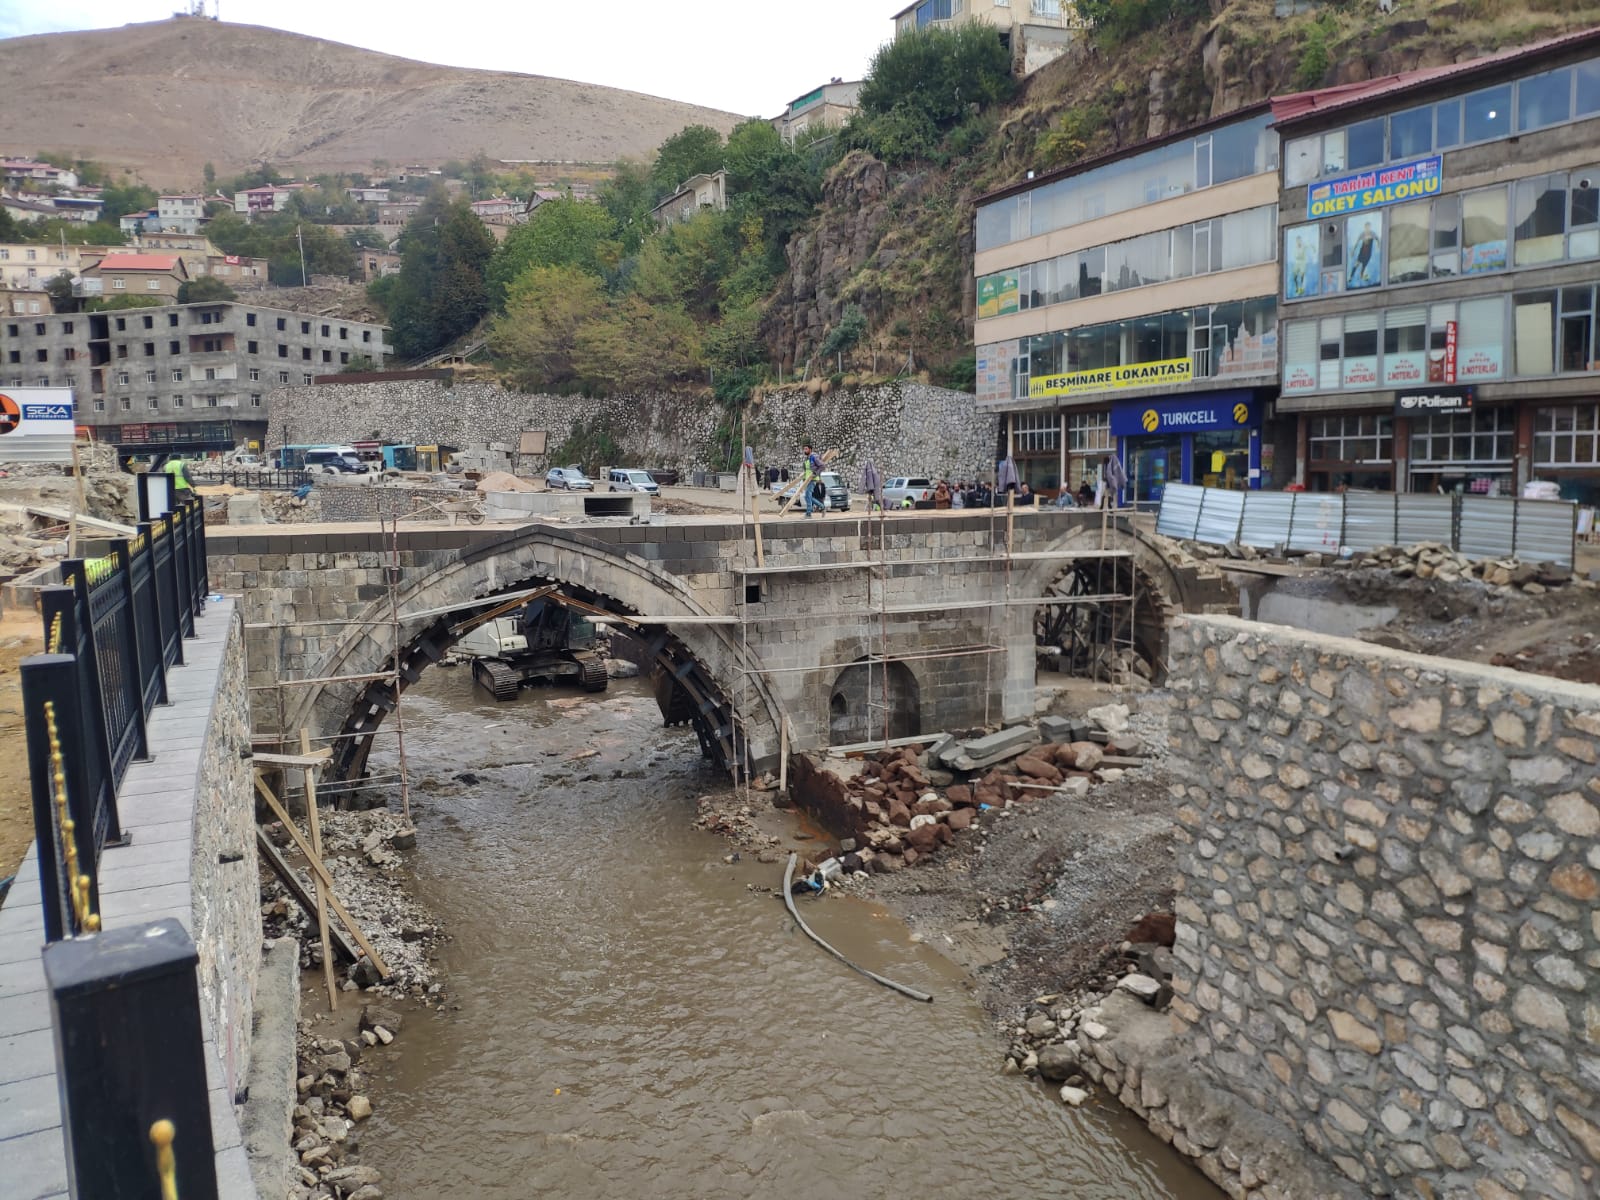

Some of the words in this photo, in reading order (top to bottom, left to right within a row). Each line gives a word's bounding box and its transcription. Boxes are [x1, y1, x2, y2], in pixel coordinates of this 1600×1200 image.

[1333, 172, 1376, 194] TARİHİ
[1380, 167, 1415, 185] KENT
[1311, 194, 1357, 215] OKEY
[1362, 177, 1438, 206] SALONU
[1046, 371, 1112, 390] BEŞMİNARE
[1116, 362, 1190, 380] LOKANTASI
[26, 406, 68, 415] SEKA
[1418, 395, 1462, 408] Polisan
[1162, 410, 1218, 426] TURKCELL
